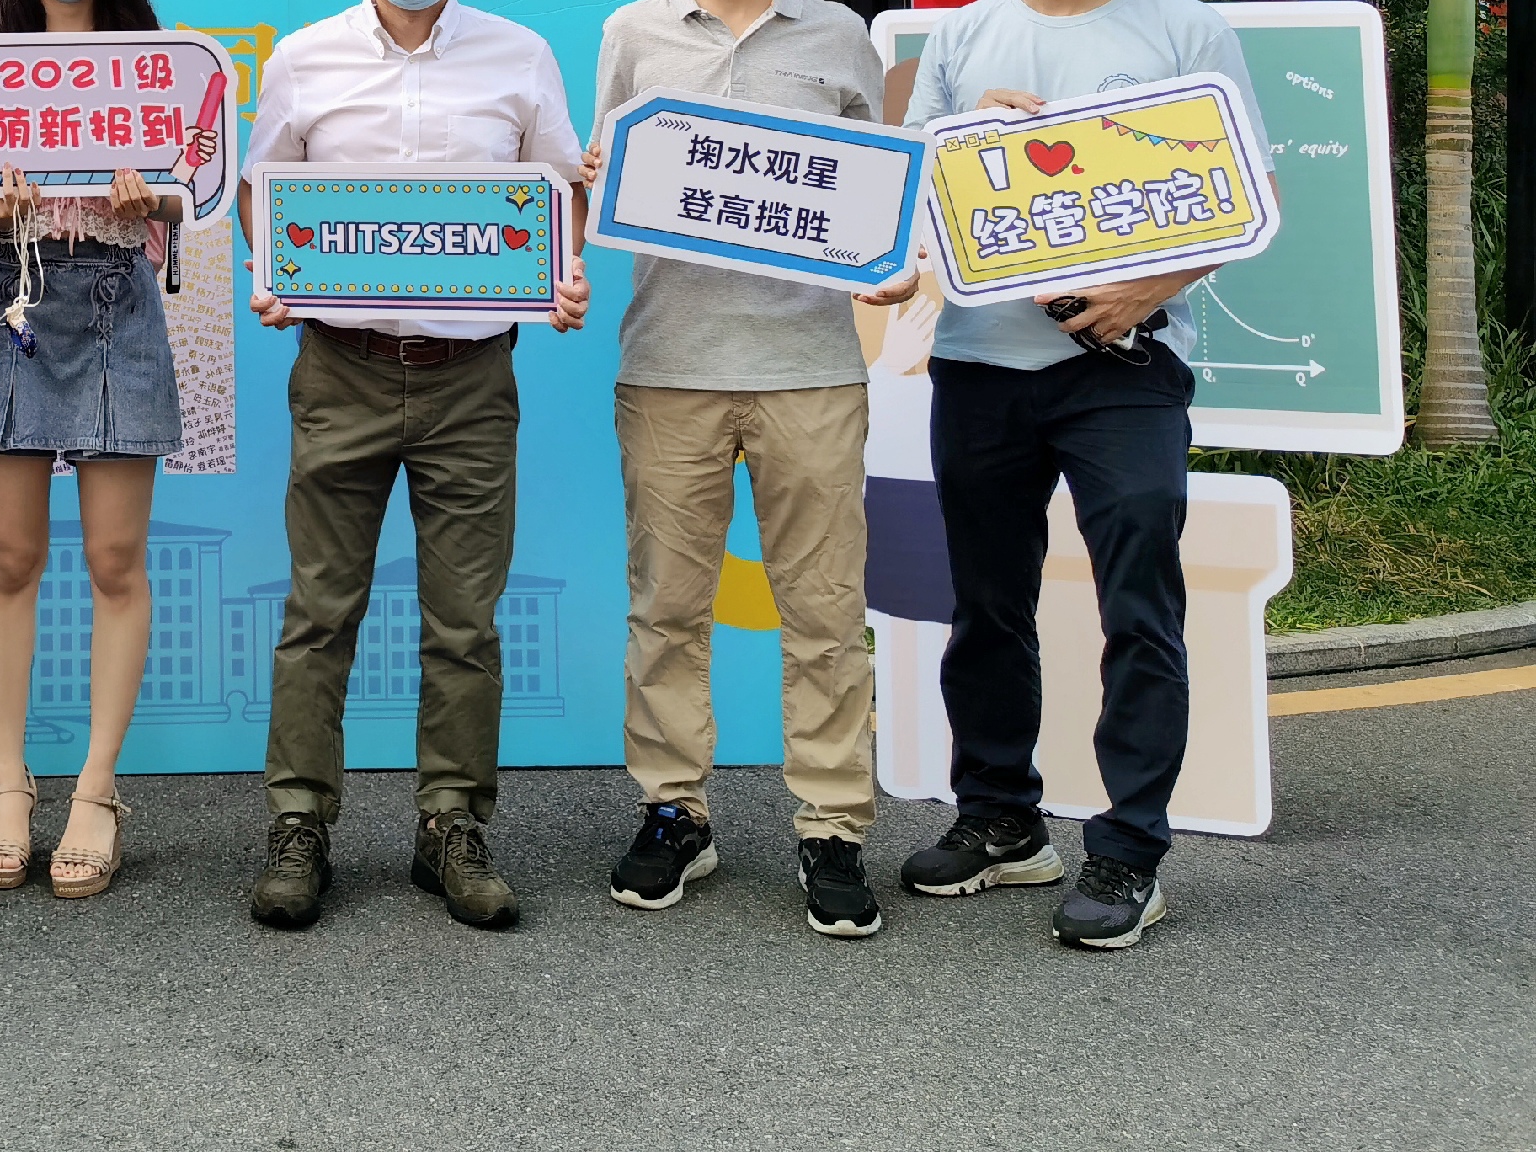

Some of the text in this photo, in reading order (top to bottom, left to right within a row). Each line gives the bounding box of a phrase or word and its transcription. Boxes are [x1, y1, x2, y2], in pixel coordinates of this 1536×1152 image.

[1286, 71, 1334, 100] options
[685, 133, 839, 191] 掬水观星
[978, 146, 1011, 191] I
[1298, 139, 1348, 158] equity
[677, 186, 831, 244] 登高揽胜
[319, 221, 500, 256] HITSZSEM
